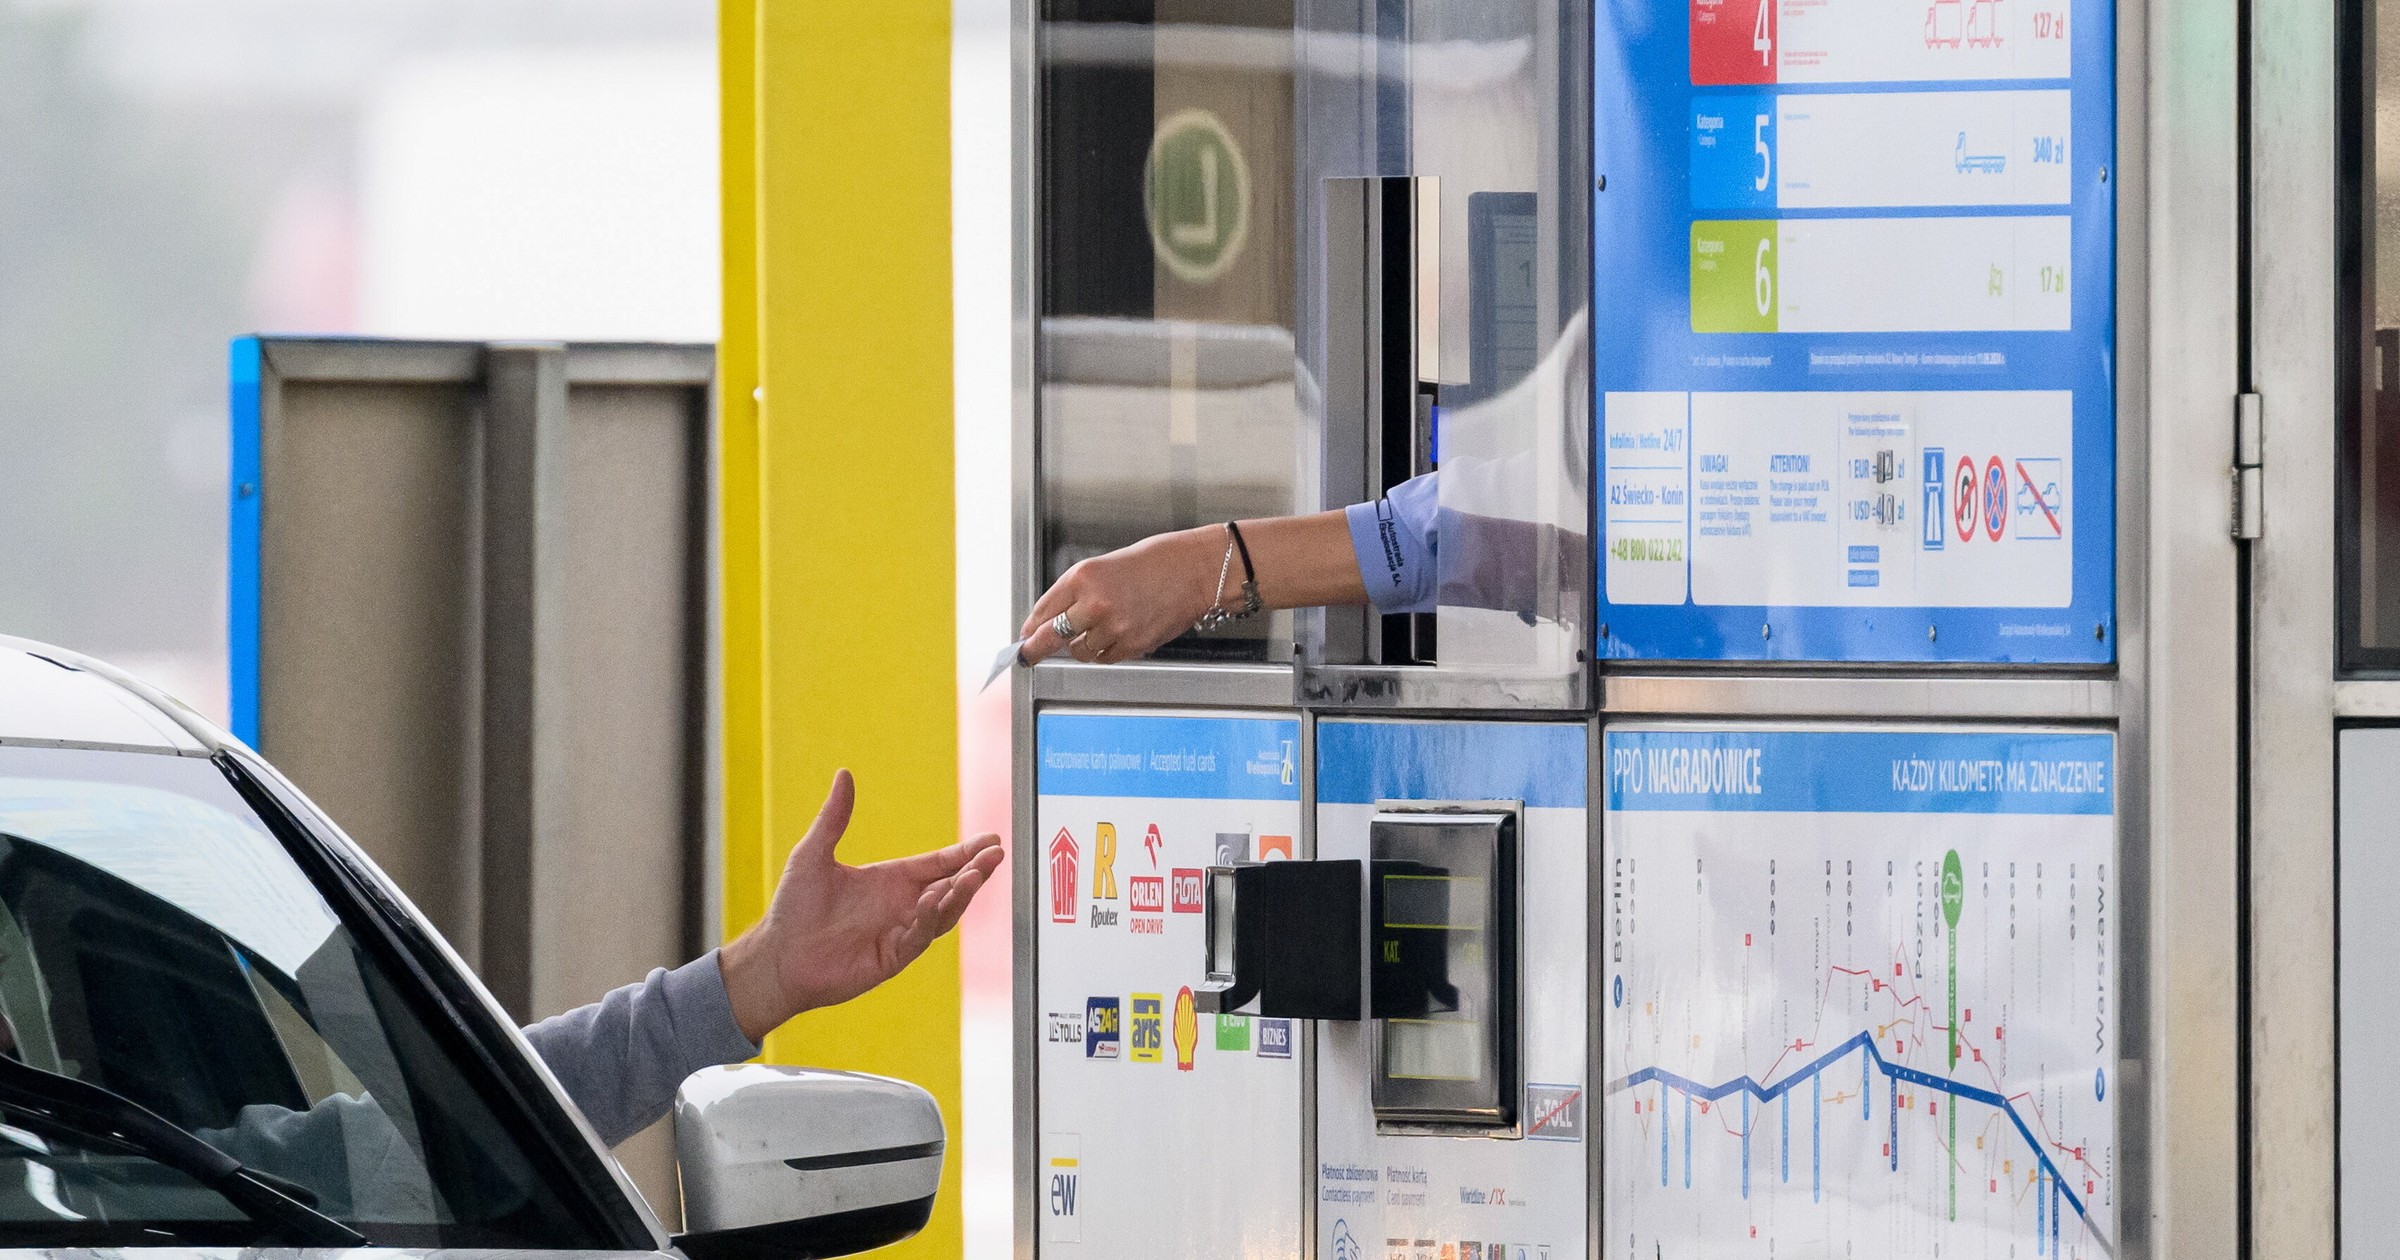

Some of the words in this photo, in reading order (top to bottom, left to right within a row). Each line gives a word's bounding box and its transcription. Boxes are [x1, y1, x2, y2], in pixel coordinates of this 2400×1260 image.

[1754, 0, 1772, 67] 4
[2033, 12, 2052, 39] 127
[2055, 12, 2064, 40] zł
[1755, 113, 1771, 192] 5
[2033, 136, 2052, 163] 340
[2055, 136, 2064, 164] zł
[1755, 238, 1772, 316] 6
[2040, 265, 2053, 292] 17
[1610, 432, 1635, 449] Infolinia
[1639, 432, 1661, 449] Hotline
[1663, 428, 1683, 452] 24/7
[1700, 454, 1729, 473] UWAGA!
[1769, 454, 1811, 473] ATTENTION!
[1854, 458, 1870, 479] EUR
[1611, 485, 1621, 505] A2
[1623, 479, 1654, 505] Świecko
[1662, 484, 1684, 505] Konin
[1854, 500, 1870, 521] USD
[1611, 538, 1628, 561] +48
[1630, 538, 1646, 561] 800
[1648, 538, 1664, 561] 022
[1667, 538, 1683, 561] 242
[1045, 747, 1090, 773] Akceptowane
[1091, 751, 1107, 775] karty
[1109, 748, 1142, 776] paliwowe
[1150, 749, 1182, 776] Accepted
[1182, 747, 1196, 772] fuel
[1197, 749, 1217, 773] cards
[1613, 747, 1644, 794] PPO
[1648, 747, 1762, 795] NAGRADOWICE
[1892, 752, 1936, 792] KAŻDY
[1938, 760, 2004, 792] KILOMETR
[2006, 760, 2028, 793] MA
[2029, 760, 2106, 794] ZNACZENIE
[1131, 881, 1163, 908] ORLEN
[1173, 876, 1202, 906] FLOTA
[1090, 904, 1118, 928] Routex
[1613, 858, 1623, 964] Berlin
[1914, 860, 1923, 980] Poznań
[1130, 918, 1145, 934] OPEN
[1146, 918, 1164, 934] DRIVE
[1383, 940, 1401, 963] KAT.
[2095, 863, 2105, 1055] Warszawa
[1060, 1023, 1082, 1043] TOLLS
[1132, 1017, 1161, 1049] aris
[1262, 1027, 1287, 1046] BIZNES
[1321, 1163, 1345, 1181] Płatność
[1386, 1165, 1412, 1185] Płatność
[1050, 1173, 1077, 1216] ew
[1321, 1185, 1351, 1204] Contactless
[1459, 1186, 1485, 1205] Worldline
